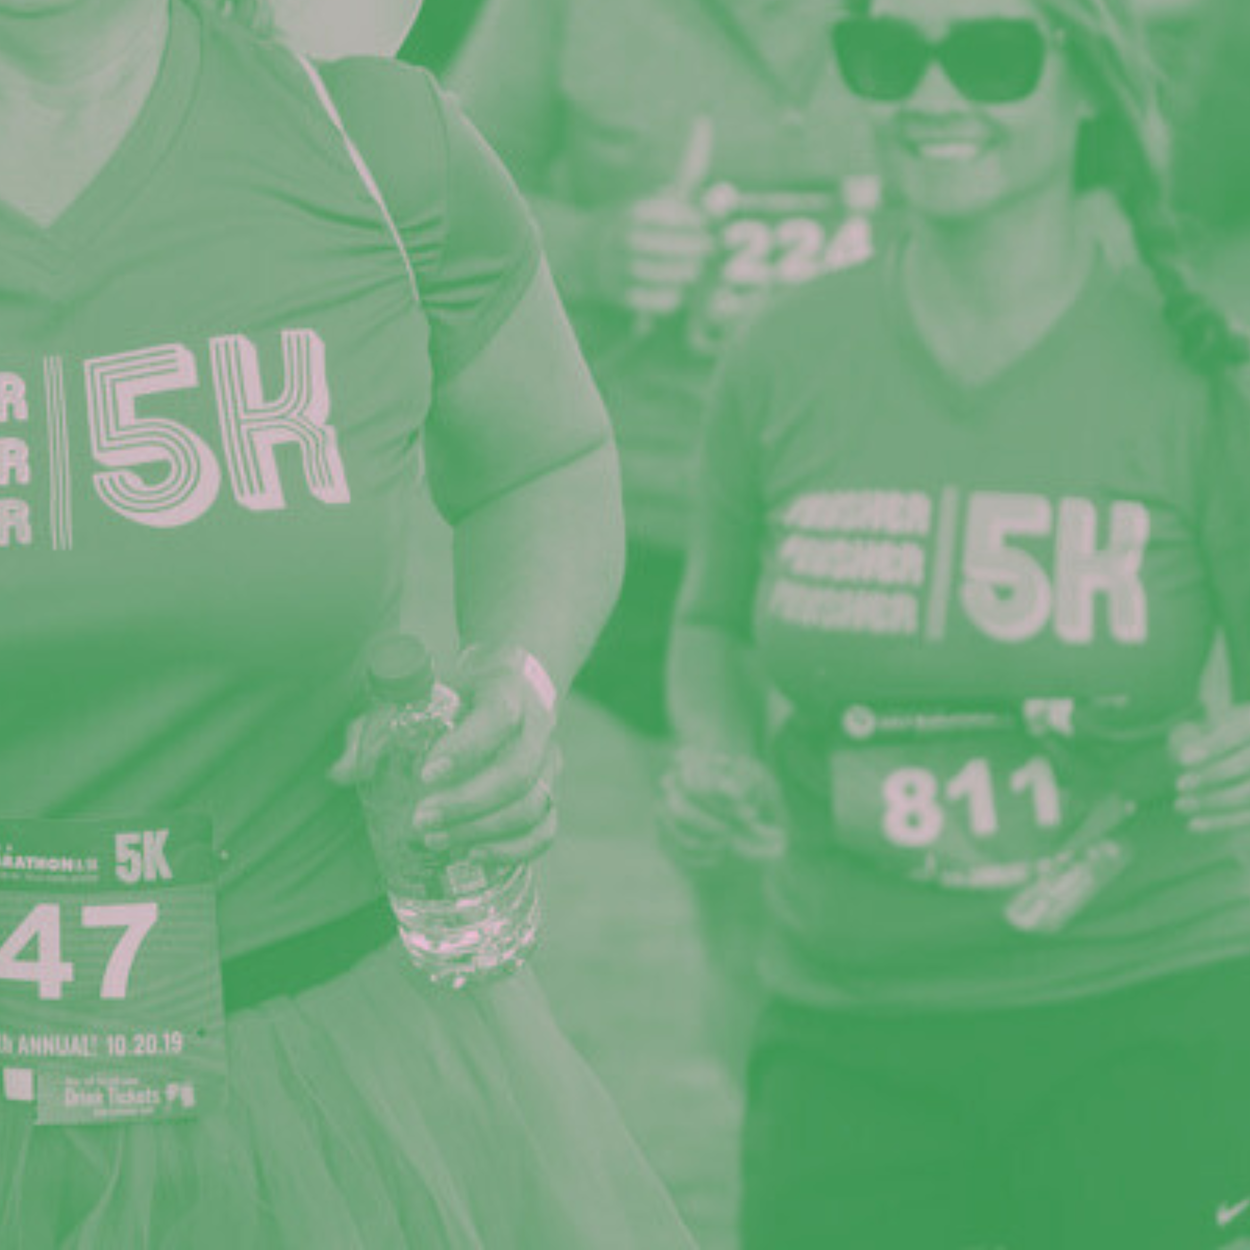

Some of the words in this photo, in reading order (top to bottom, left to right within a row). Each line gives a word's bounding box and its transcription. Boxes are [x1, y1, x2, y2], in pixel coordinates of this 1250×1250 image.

[83, 327, 351, 528] 5K
[959, 489, 1150, 645] 5K
[880, 756, 1063, 848] 811
[114, 828, 173, 885] 5K
[106, 1030, 184, 1057] 10.20.19
